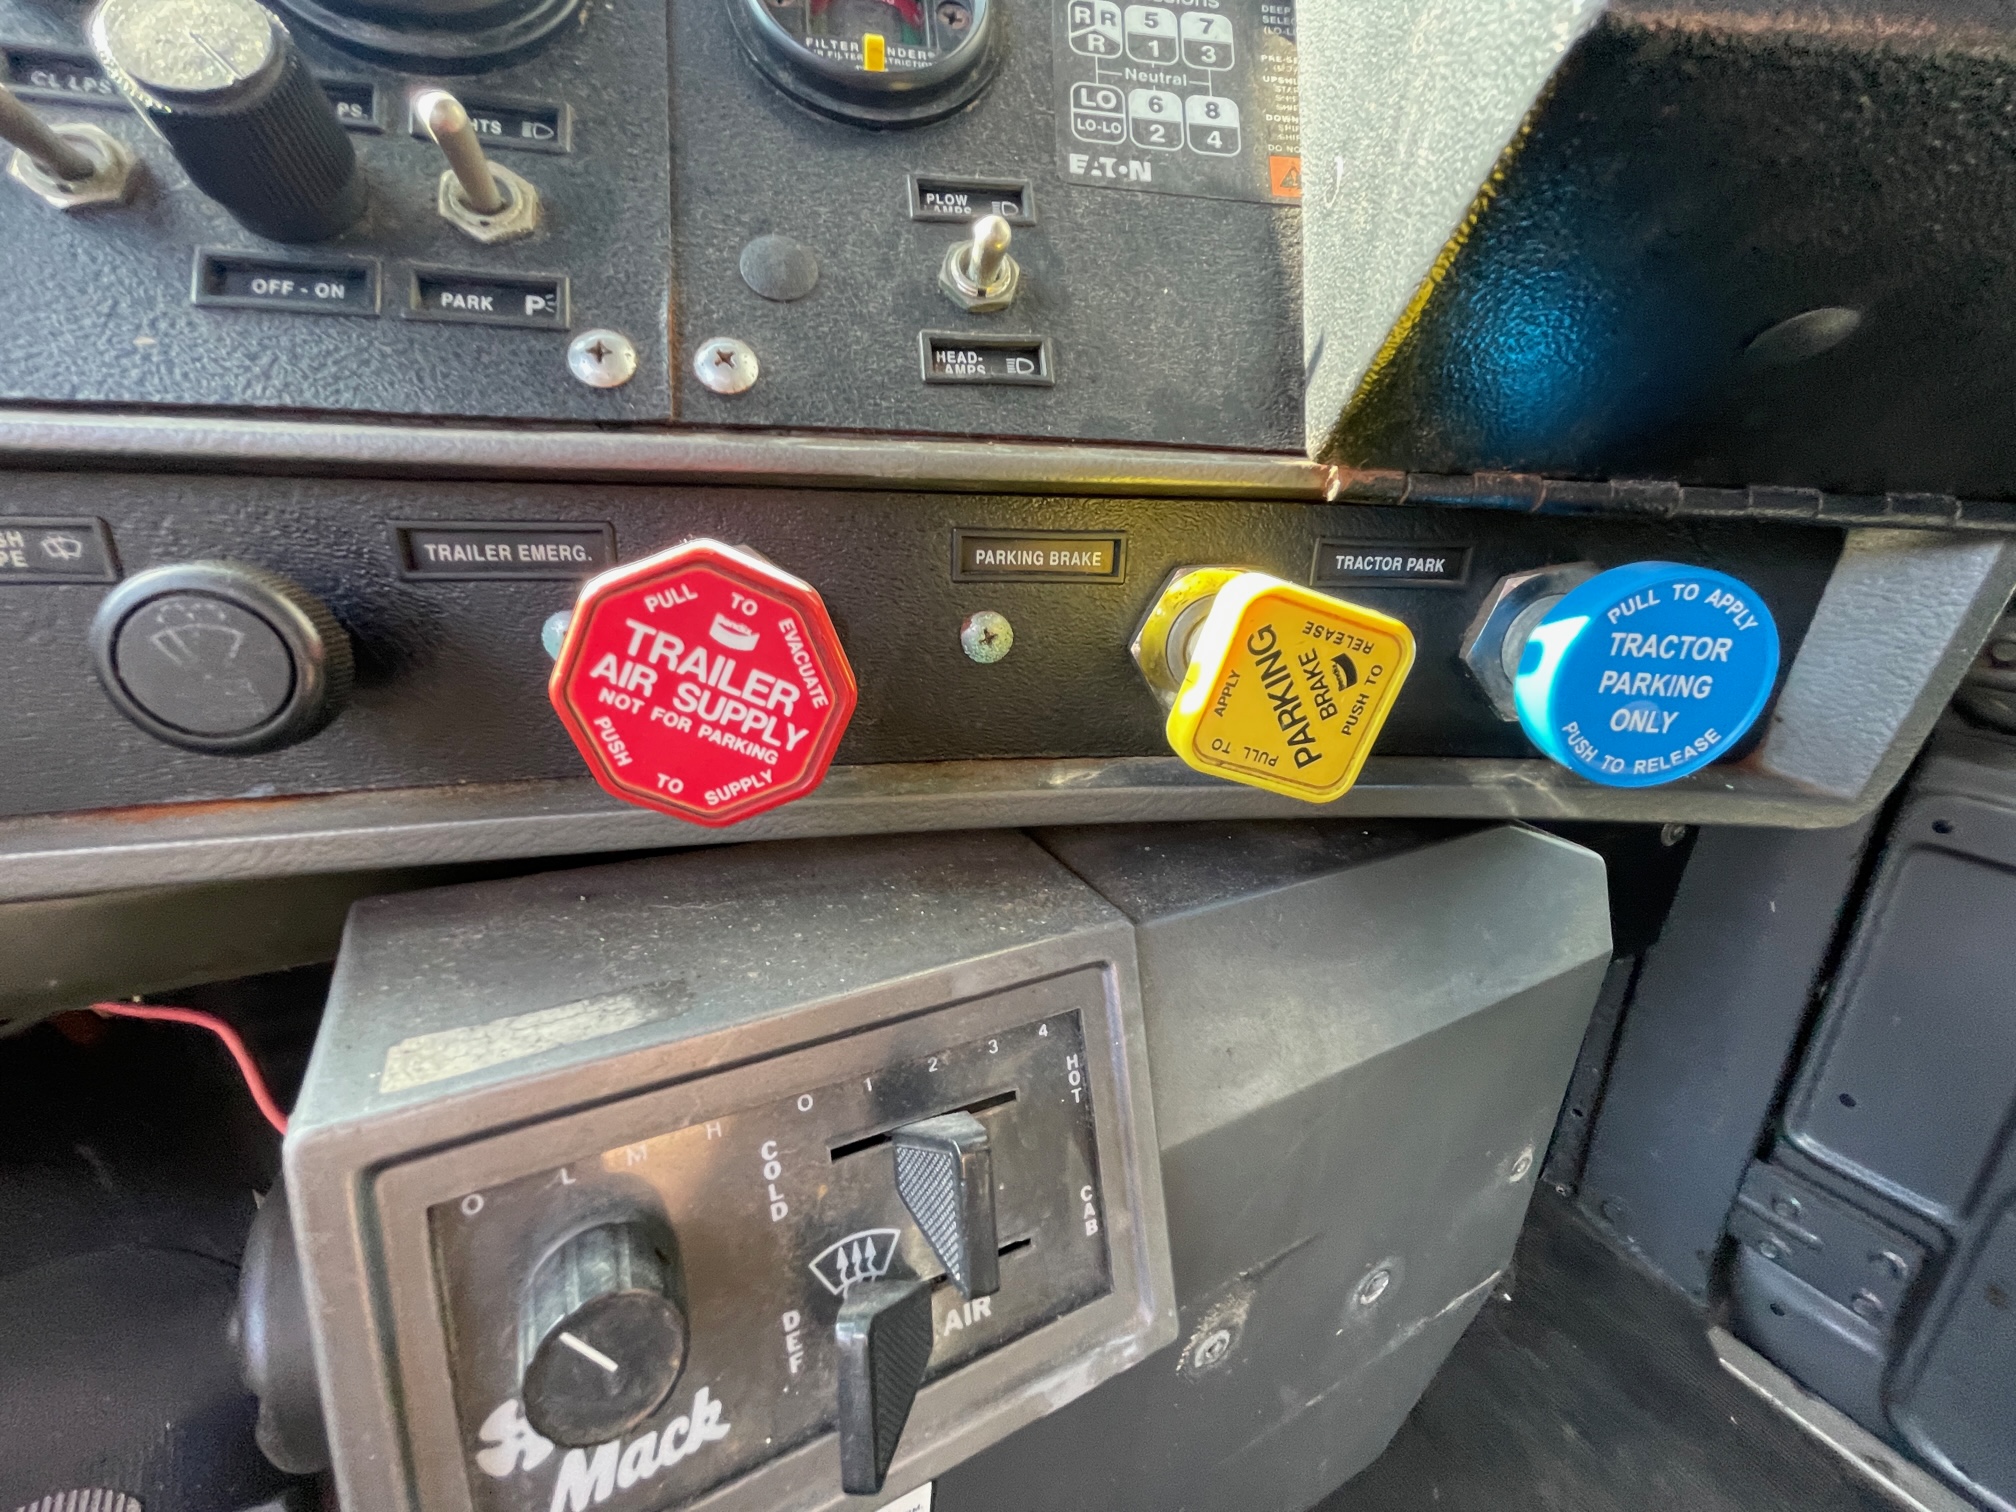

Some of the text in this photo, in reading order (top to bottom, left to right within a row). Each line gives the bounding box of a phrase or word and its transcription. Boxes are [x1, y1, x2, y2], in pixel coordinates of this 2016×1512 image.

[1074, 6, 1091, 24] R
[1100, 10, 1117, 27] R
[1143, 12, 1159, 29] 5
[1199, 17, 1215, 35] 7
[805, 37, 860, 53] FILTER
[1088, 34, 1105, 53] R
[1148, 40, 1160, 58] 1
[1201, 46, 1217, 63] 3
[1125, 67, 1188, 87] Neutral
[1080, 88, 1118, 109] LO
[1148, 95, 1164, 113] 6
[1205, 101, 1221, 119] 8
[1077, 118, 1122, 135] LO-LO
[1149, 124, 1166, 143] 2
[1206, 130, 1223, 149] 4
[926, 193, 968, 207] PLOW
[252, 278, 294, 295] OFF
[314, 282, 345, 299] ON
[440, 292, 494, 311] PARK
[936, 350, 983, 364] HEAD-
[424, 544, 593, 562] TRAILER EMERG.
[975, 549, 1102, 567] PARKING BRAKE
[1335, 555, 1446, 573] TRACTOR PARK
[1607, 583, 1759, 632] PULL TO APPLY
[644, 584, 698, 613] PULL
[731, 592, 759, 616] TO
[777, 617, 829, 710] EVACUATE
[1302, 620, 1375, 655] RELEASE
[1609, 632, 1733, 662] TRACTOR
[625, 617, 801, 718] TRAILER
[1213, 668, 1241, 718] APPLY
[1246, 623, 1323, 769] PARKING
[1297, 647, 1339, 721] BRAKE
[1598, 670, 1714, 699] PARKING
[589, 652, 810, 752] AIR SUPPLY
[1341, 663, 1384, 736] PUSH TO
[598, 687, 779, 766] NOT FOR PARKING
[1609, 708, 1680, 734] ONLY
[593, 715, 774, 806] PUSH TO SUPPLY
[1211, 737, 1280, 767] PULL TO
[1561, 721, 1722, 775] PUSH TO RELEASE
[863, 1076, 873, 1092] 1
[928, 1057, 939, 1073] 2
[988, 1039, 999, 1054] 3
[1038, 1023, 1049, 1037] 4
[1066, 1053, 1084, 1104] HOT
[559, 1168, 577, 1185] L
[626, 1144, 648, 1167] M
[706, 1122, 722, 1140] H
[760, 1140, 789, 1222] COLD
[1080, 1185, 1099, 1236] CAB
[944, 1295, 992, 1337] AIR
[782, 1310, 804, 1374] DEF
[549, 1386, 731, 1512] Mack
